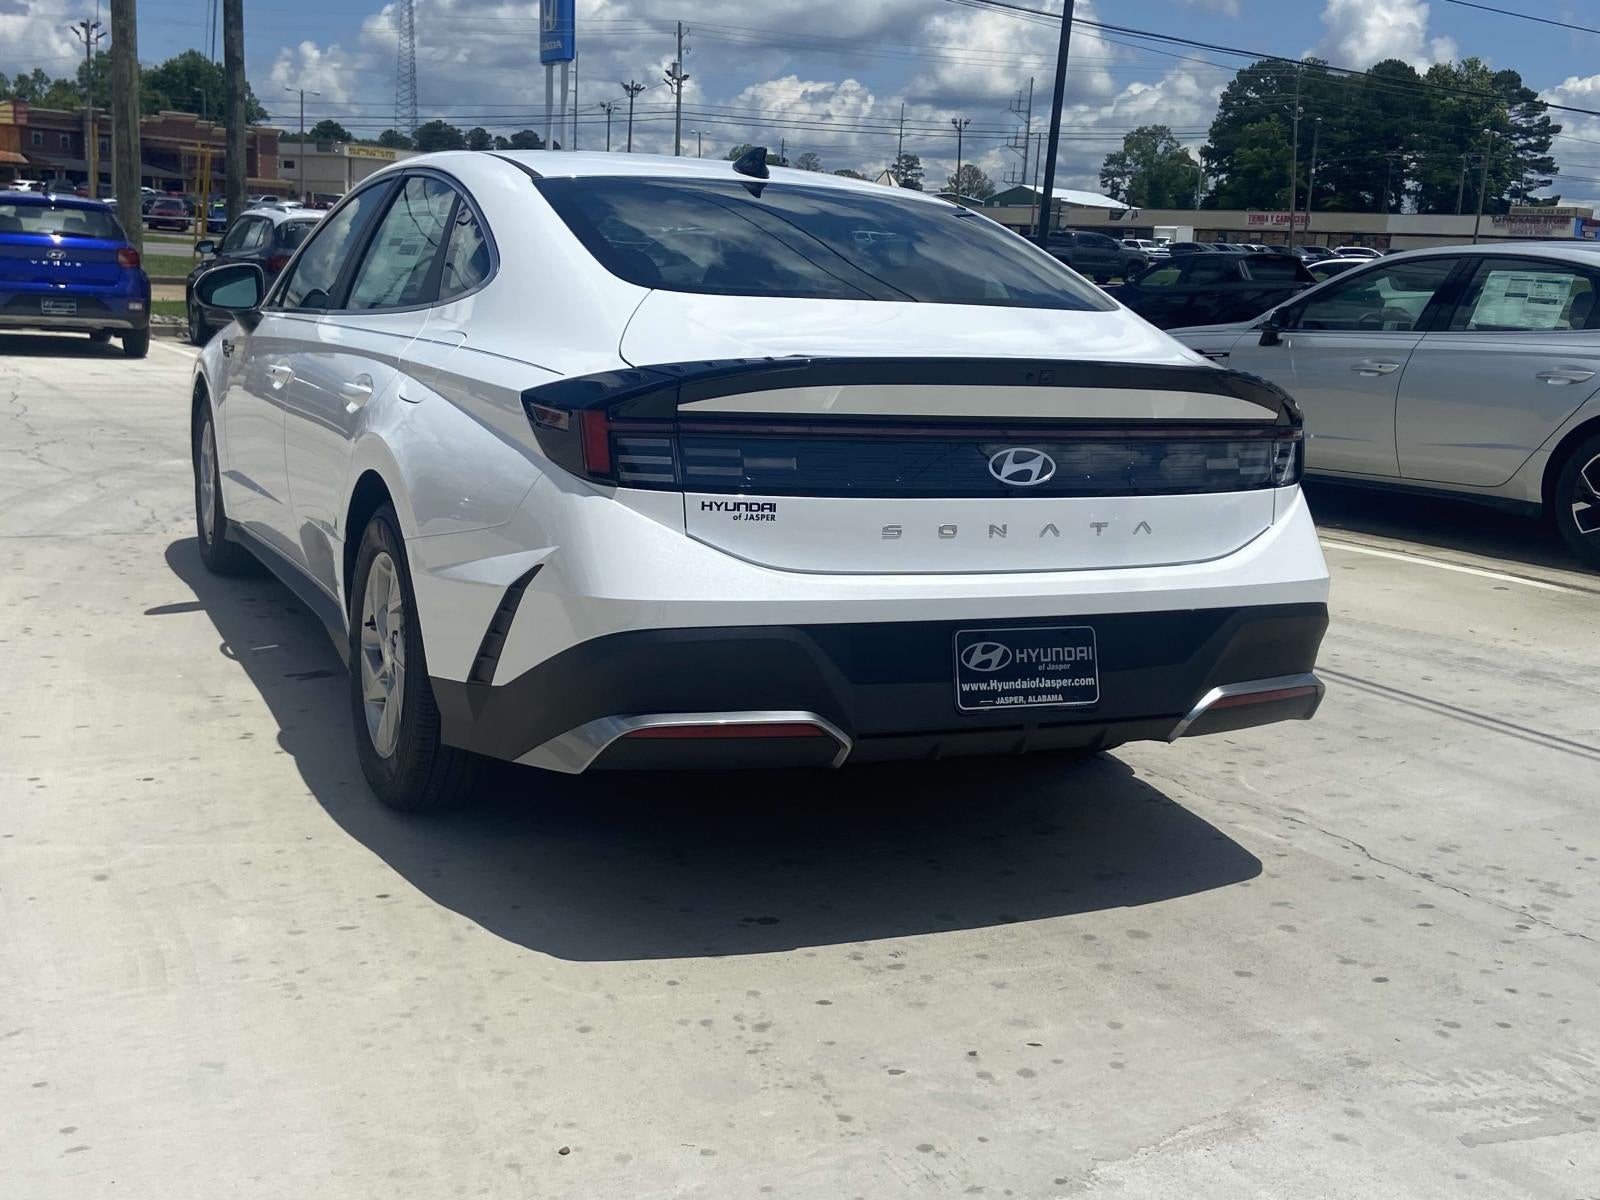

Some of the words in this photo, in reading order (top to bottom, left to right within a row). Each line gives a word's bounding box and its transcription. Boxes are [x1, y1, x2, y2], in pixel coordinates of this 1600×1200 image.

[1248, 214, 1268, 222] TIENDA
[1271, 214, 1275, 222] Y
[701, 501, 776, 512] HYUNDAI
[744, 514, 776, 522] JASPER
[881, 520, 1152, 539] SONATA
[1016, 646, 1092, 664] HYUNDAI
[1047, 663, 1070, 672] Jasper
[961, 676, 1095, 692] www.HyundaiofJasper.com
[996, 696, 1026, 704] JASPER,
[1028, 694, 1063, 702] ALABAMA
